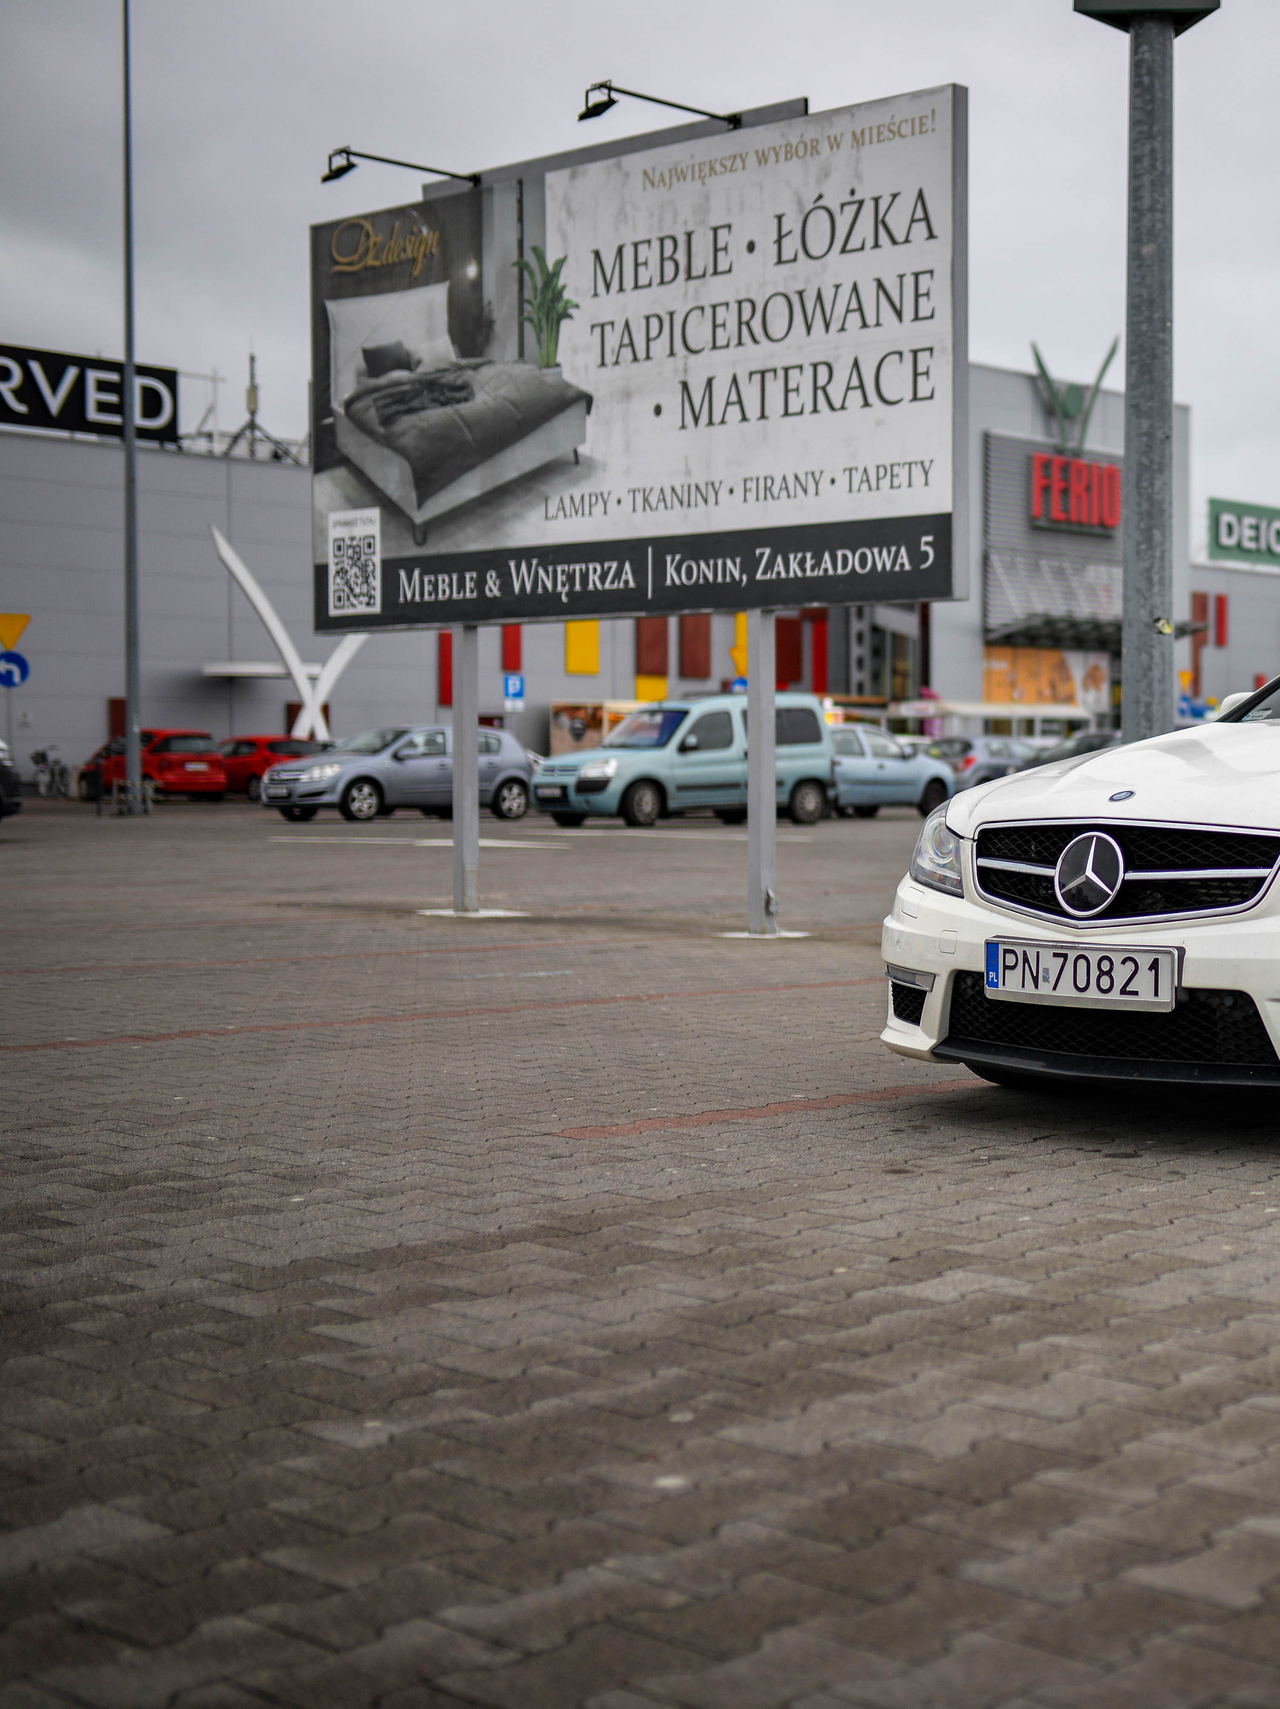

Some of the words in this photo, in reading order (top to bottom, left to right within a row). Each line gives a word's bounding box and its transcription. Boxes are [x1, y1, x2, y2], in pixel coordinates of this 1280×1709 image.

[642, 151, 749, 191] NAJWIĘKSZY
[754, 134, 821, 166] WYBÓR
[826, 132, 845, 152] W
[850, 108, 936, 148] MIEŚCIE!
[591, 223, 733, 298] MEBLE
[773, 187, 939, 266] ŁÓŻKA
[591, 269, 935, 368] TAPICEROWANE
[678, 346, 935, 430] MATERACE
[544, 491, 612, 521] LAMPY
[628, 480, 724, 514] TKANINY
[742, 470, 825, 503] FIRANY
[843, 459, 935, 494] TAPETY
[1032, 452, 1123, 528] FERIO
[398, 567, 477, 604] MEBLE
[484, 569, 502, 598] &
[508, 558, 637, 604] WNĘTRZA
[665, 554, 748, 587] KONIN,
[755, 545, 912, 581] ZAKŁADOWA
[920, 535, 935, 569] 5
[989, 972, 998, 982] PL
[1002, 948, 1040, 990] PN
[1052, 953, 1160, 997] 70821
